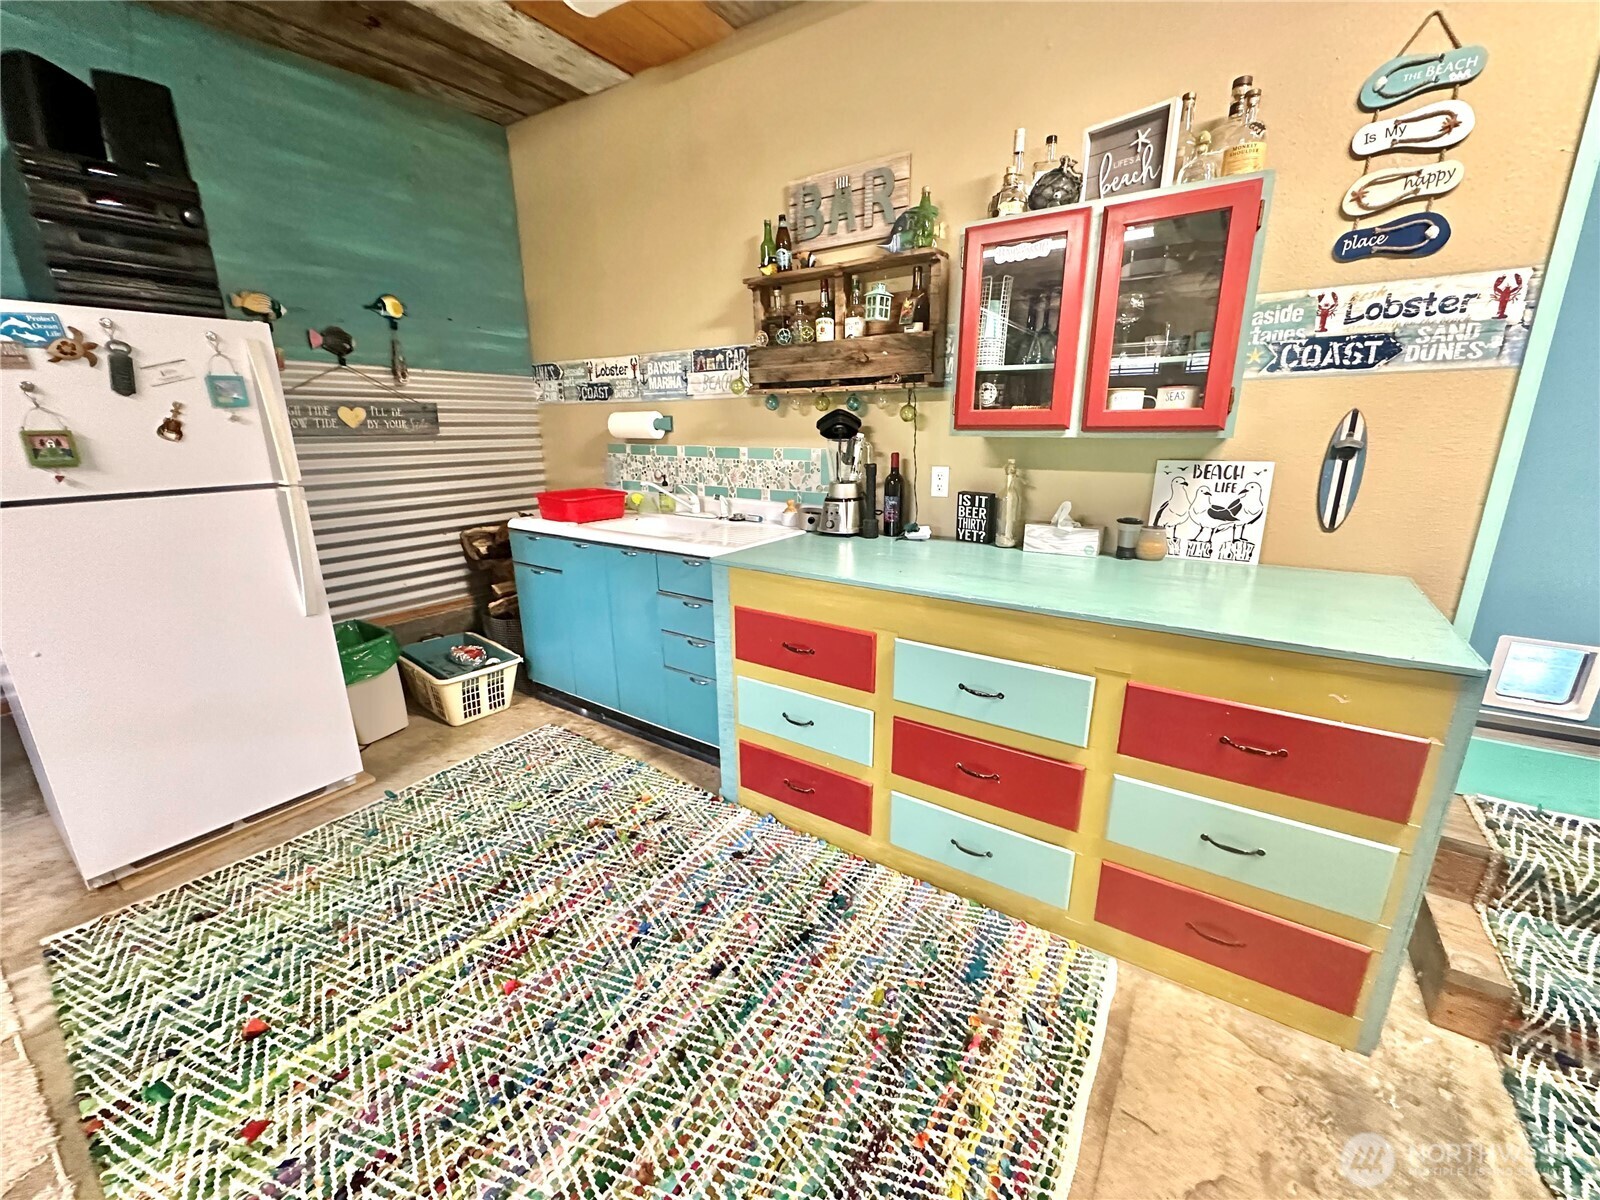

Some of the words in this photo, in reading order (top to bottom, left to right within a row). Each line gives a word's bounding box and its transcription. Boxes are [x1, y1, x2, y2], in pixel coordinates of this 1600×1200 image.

[1403, 70, 1423, 82] THE
[1425, 56, 1479, 77] BEACH
[1364, 132, 1377, 145] Is
[1384, 124, 1407, 138] My
[1232, 143, 1258, 151] MONKEY
[1099, 143, 1162, 199] beach
[1403, 166, 1457, 190] happy
[796, 168, 895, 242] BAR
[1341, 233, 1389, 255] place
[1343, 291, 1478, 325] Lobster
[25, 314, 56, 322] Protect
[31, 322, 59, 330] Ocean
[1415, 322, 1482, 344] SAND
[1279, 340, 1384, 368] COAST
[1404, 341, 1484, 362] DUNES
[595, 363, 629, 379] Lobster
[647, 360, 682, 376] BAYSIDE
[648, 375, 683, 390] MARINA
[581, 386, 609, 400] COAST
[1165, 391, 1186, 402] SEAS
[306, 404, 331, 417] TIDE
[391, 407, 404, 417] BE
[313, 417, 338, 429] TIDE
[367, 419, 379, 429] BY
[384, 419, 408, 430] YOUR
[1192, 463, 1245, 480] BEACH
[1214, 482, 1237, 494] LIFE
[958, 493, 971, 507] IS
[975, 495, 989, 508] IT
[958, 505, 987, 520] BEER
[957, 517, 987, 531] THIRTY
[957, 527, 986, 543] YET?
